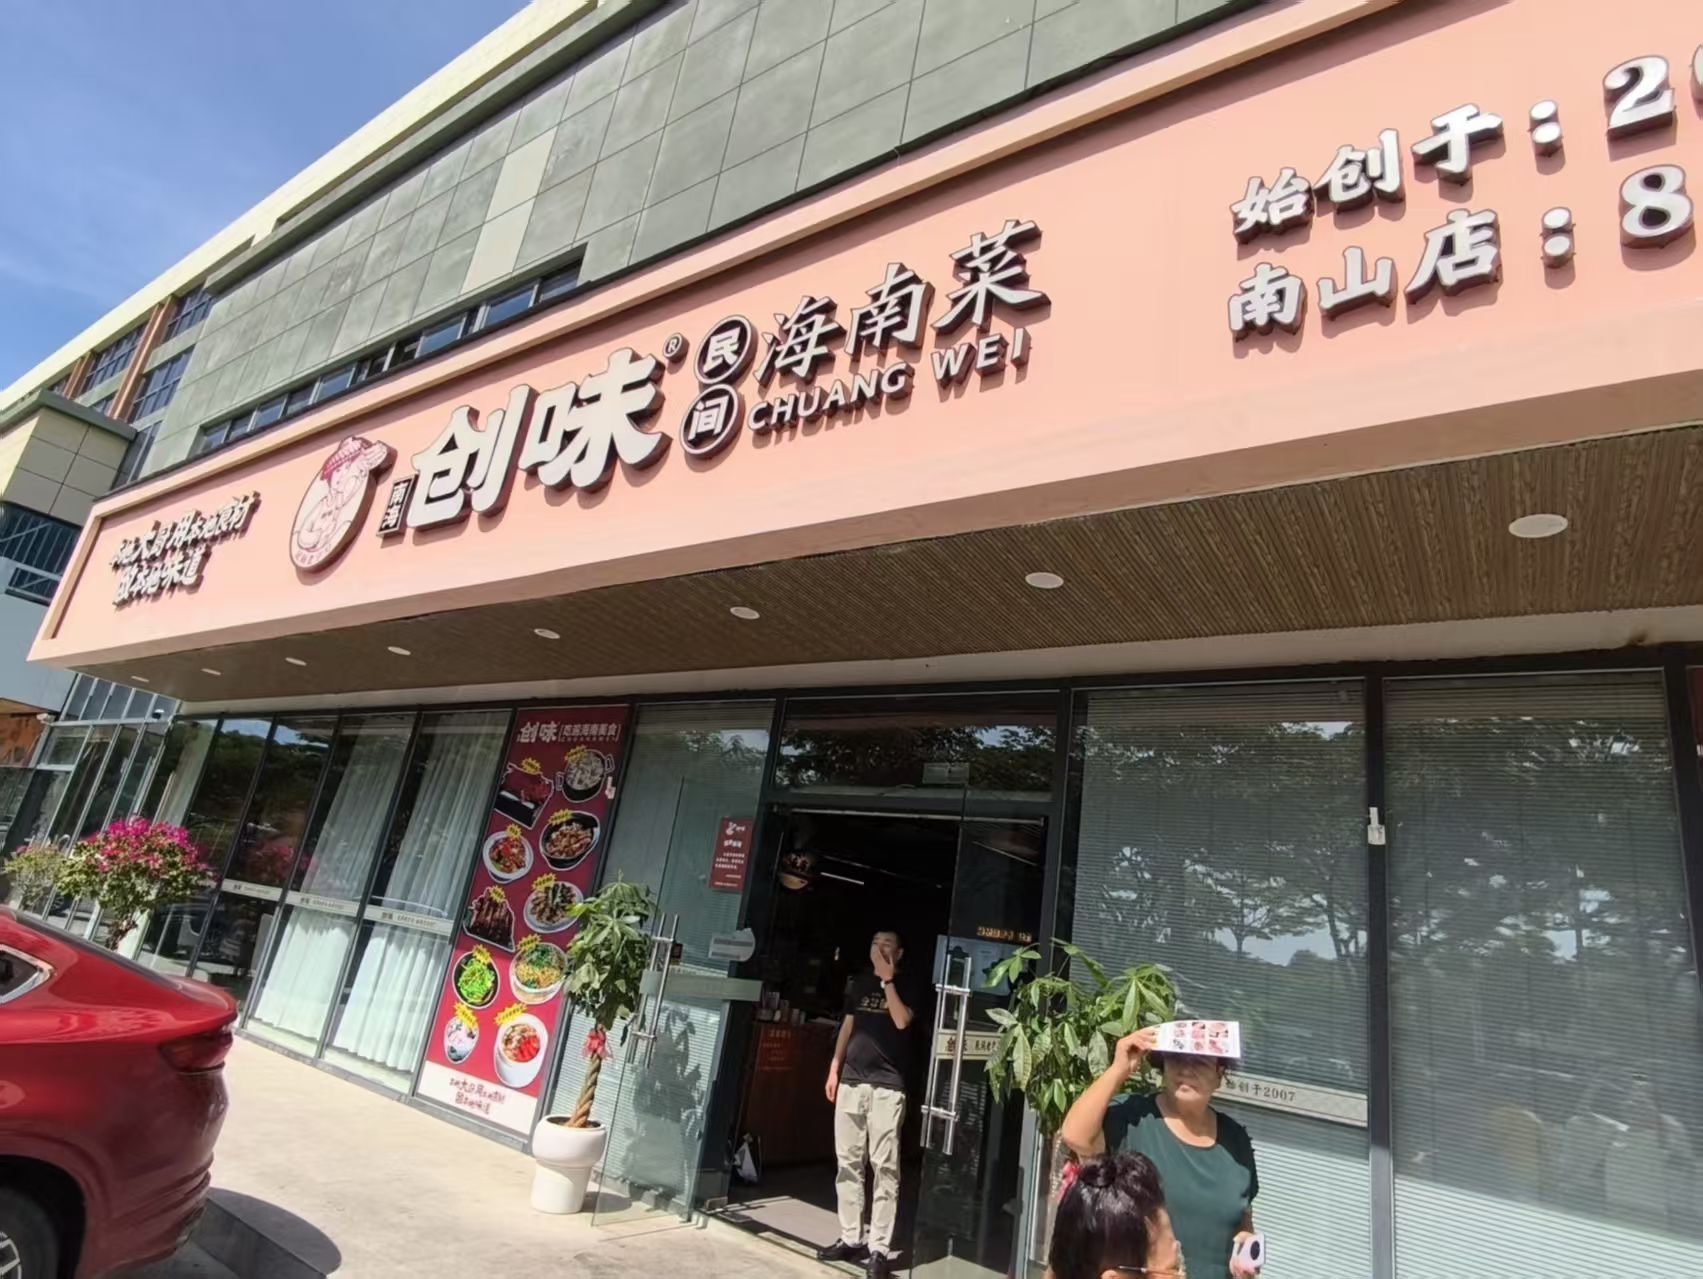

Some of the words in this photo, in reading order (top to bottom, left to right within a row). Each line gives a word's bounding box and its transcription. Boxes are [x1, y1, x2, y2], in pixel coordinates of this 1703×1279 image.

[1231, 44, 1703, 241] 始创于：2
[747, 361, 913, 434] CHUANG
[931, 327, 1030, 386] WEI
[753, 219, 1051, 386] 海南菜
[407, 347, 671, 528] 创味
[517, 721, 558, 743] 创味
